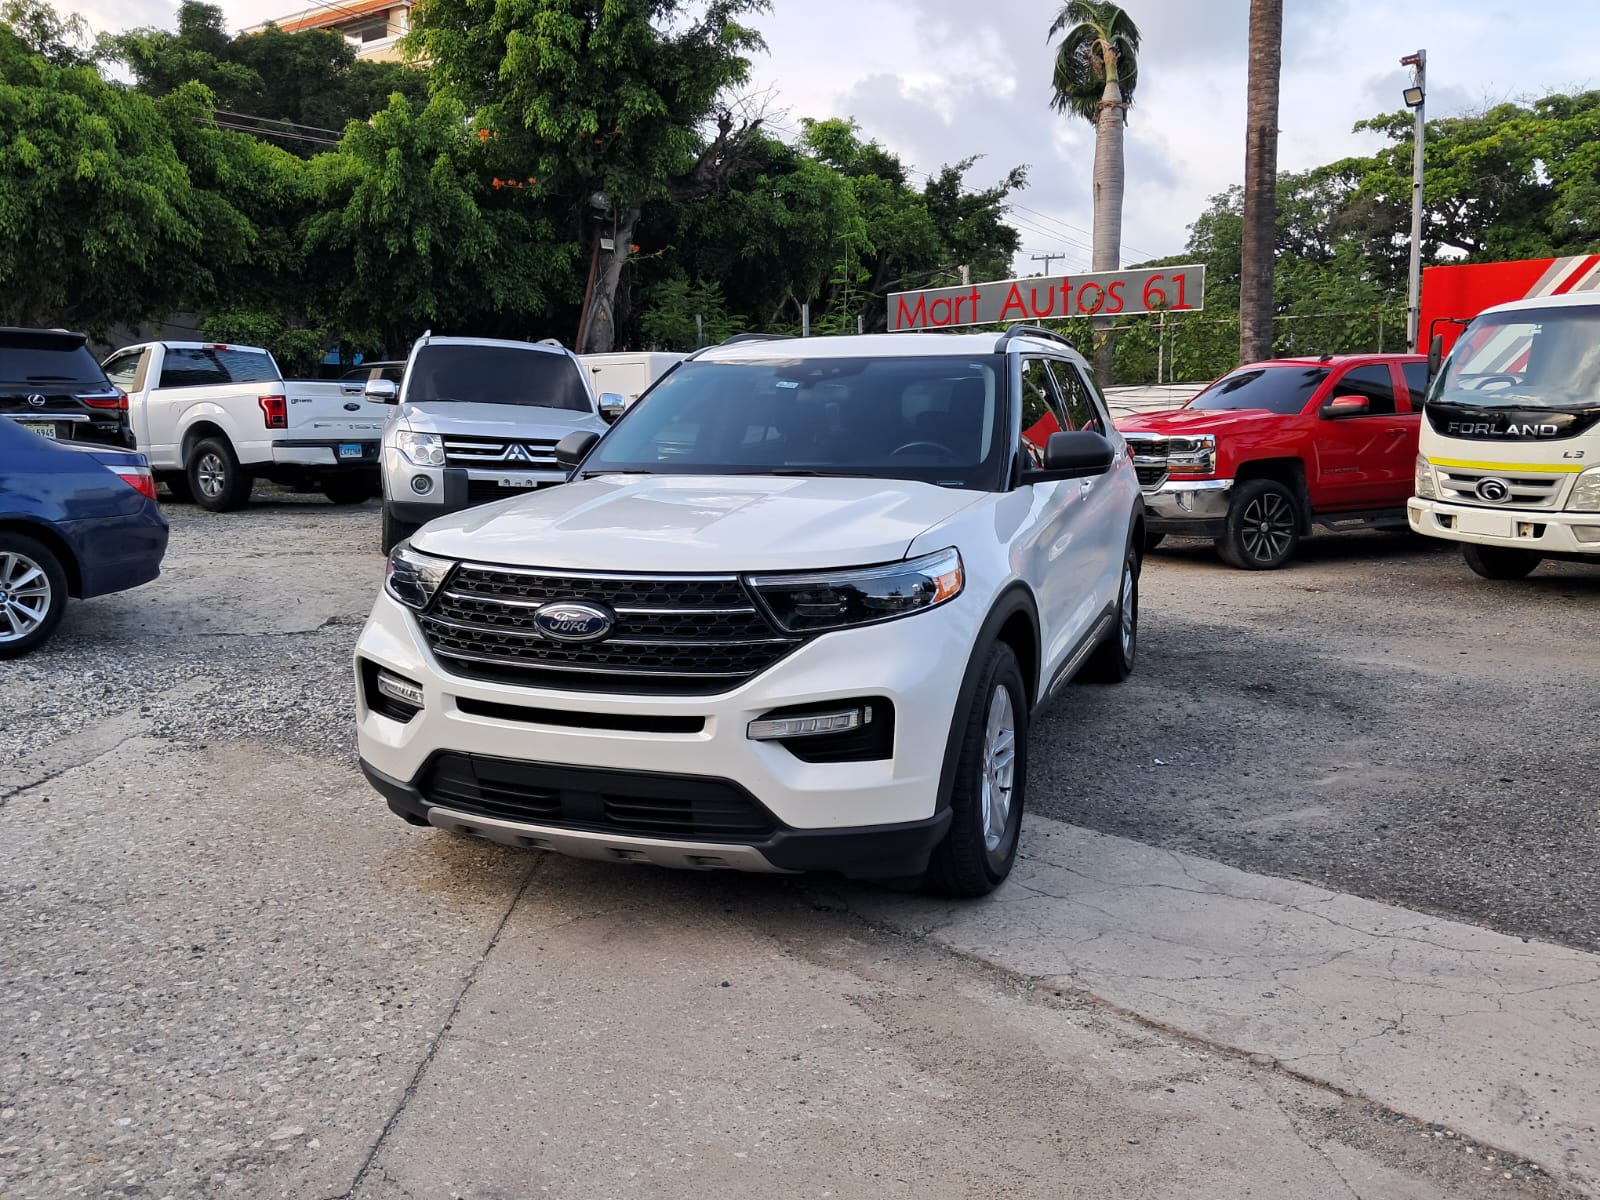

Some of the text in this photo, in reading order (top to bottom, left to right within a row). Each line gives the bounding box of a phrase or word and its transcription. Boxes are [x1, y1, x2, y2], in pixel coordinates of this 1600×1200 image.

[896, 273, 1192, 330] Mart Autos 61
[1447, 421, 1559, 437] FORLAND
[1562, 450, 1585, 459] L3
[549, 611, 590, 632] Ford
